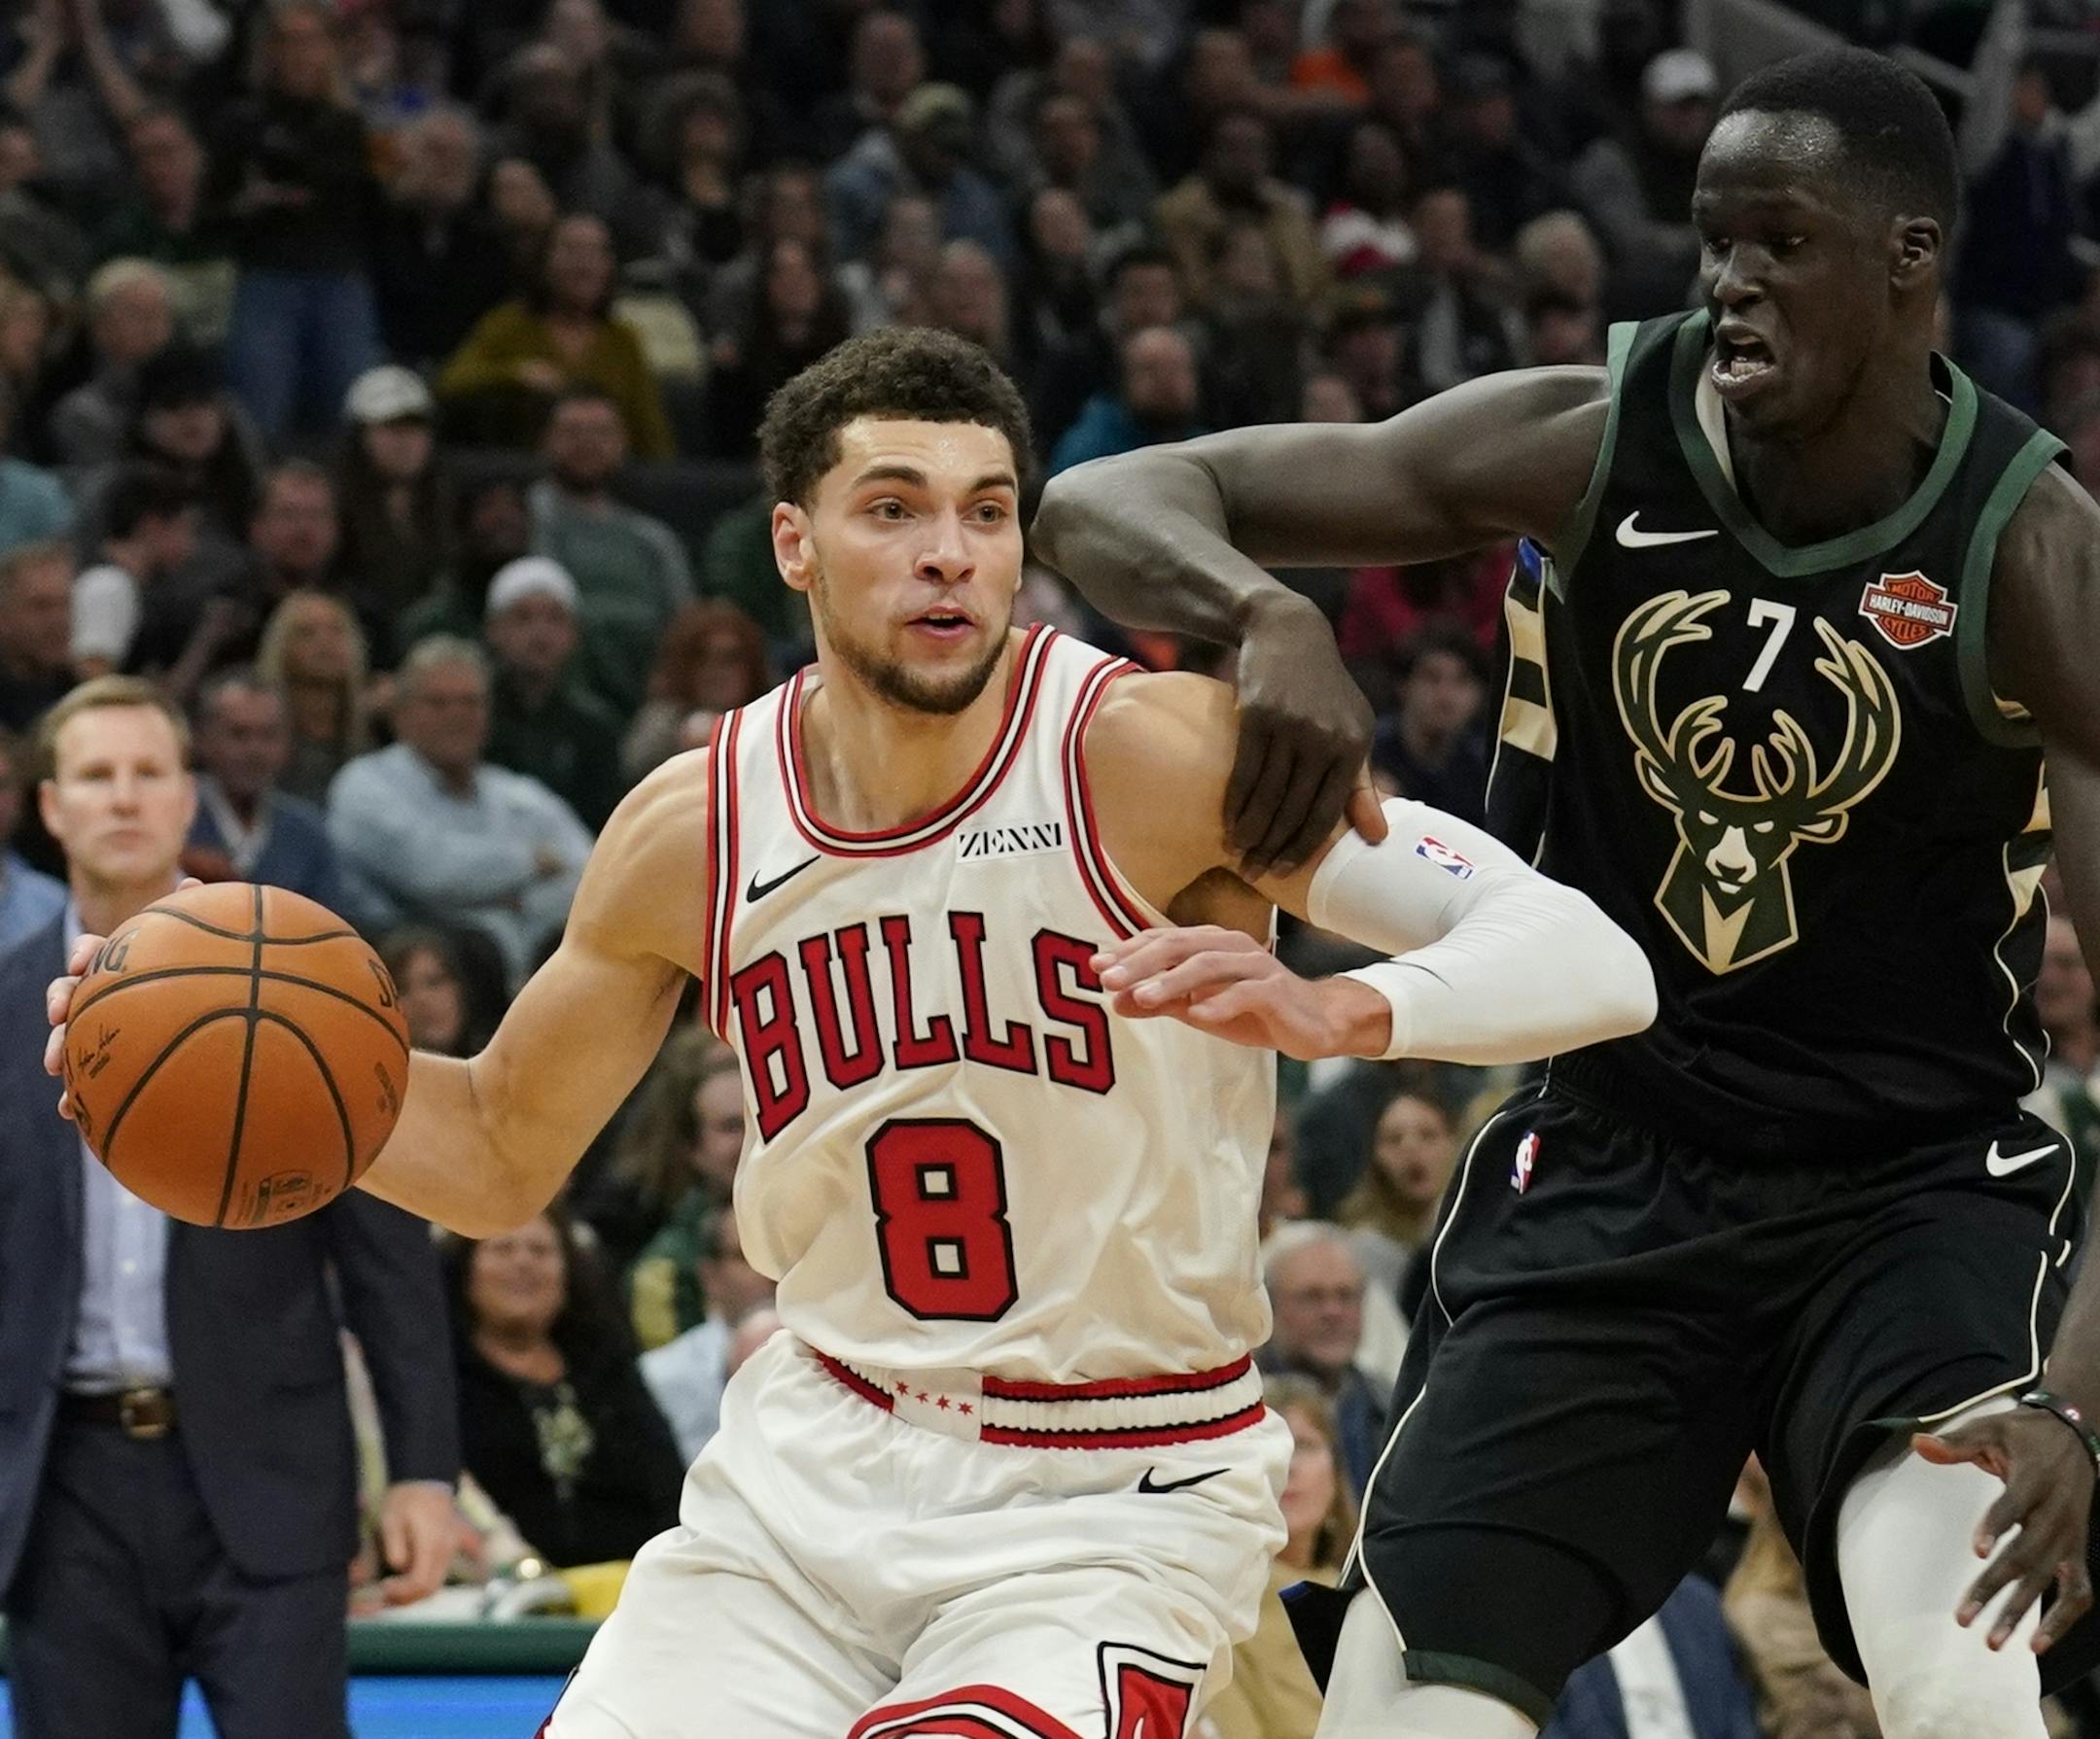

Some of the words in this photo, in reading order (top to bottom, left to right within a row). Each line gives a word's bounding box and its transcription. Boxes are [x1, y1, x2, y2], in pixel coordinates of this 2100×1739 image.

[1869, 593, 1949, 626] HARLEY-DAVIDSON
[1890, 583, 1936, 602] MOTOR
[1742, 597, 1797, 692] 7
[1878, 615, 1927, 642] CYCLES
[959, 822, 1062, 857] ZENNI
[730, 910, 1116, 1145] BULLS
[864, 1117, 1019, 1323] 8
